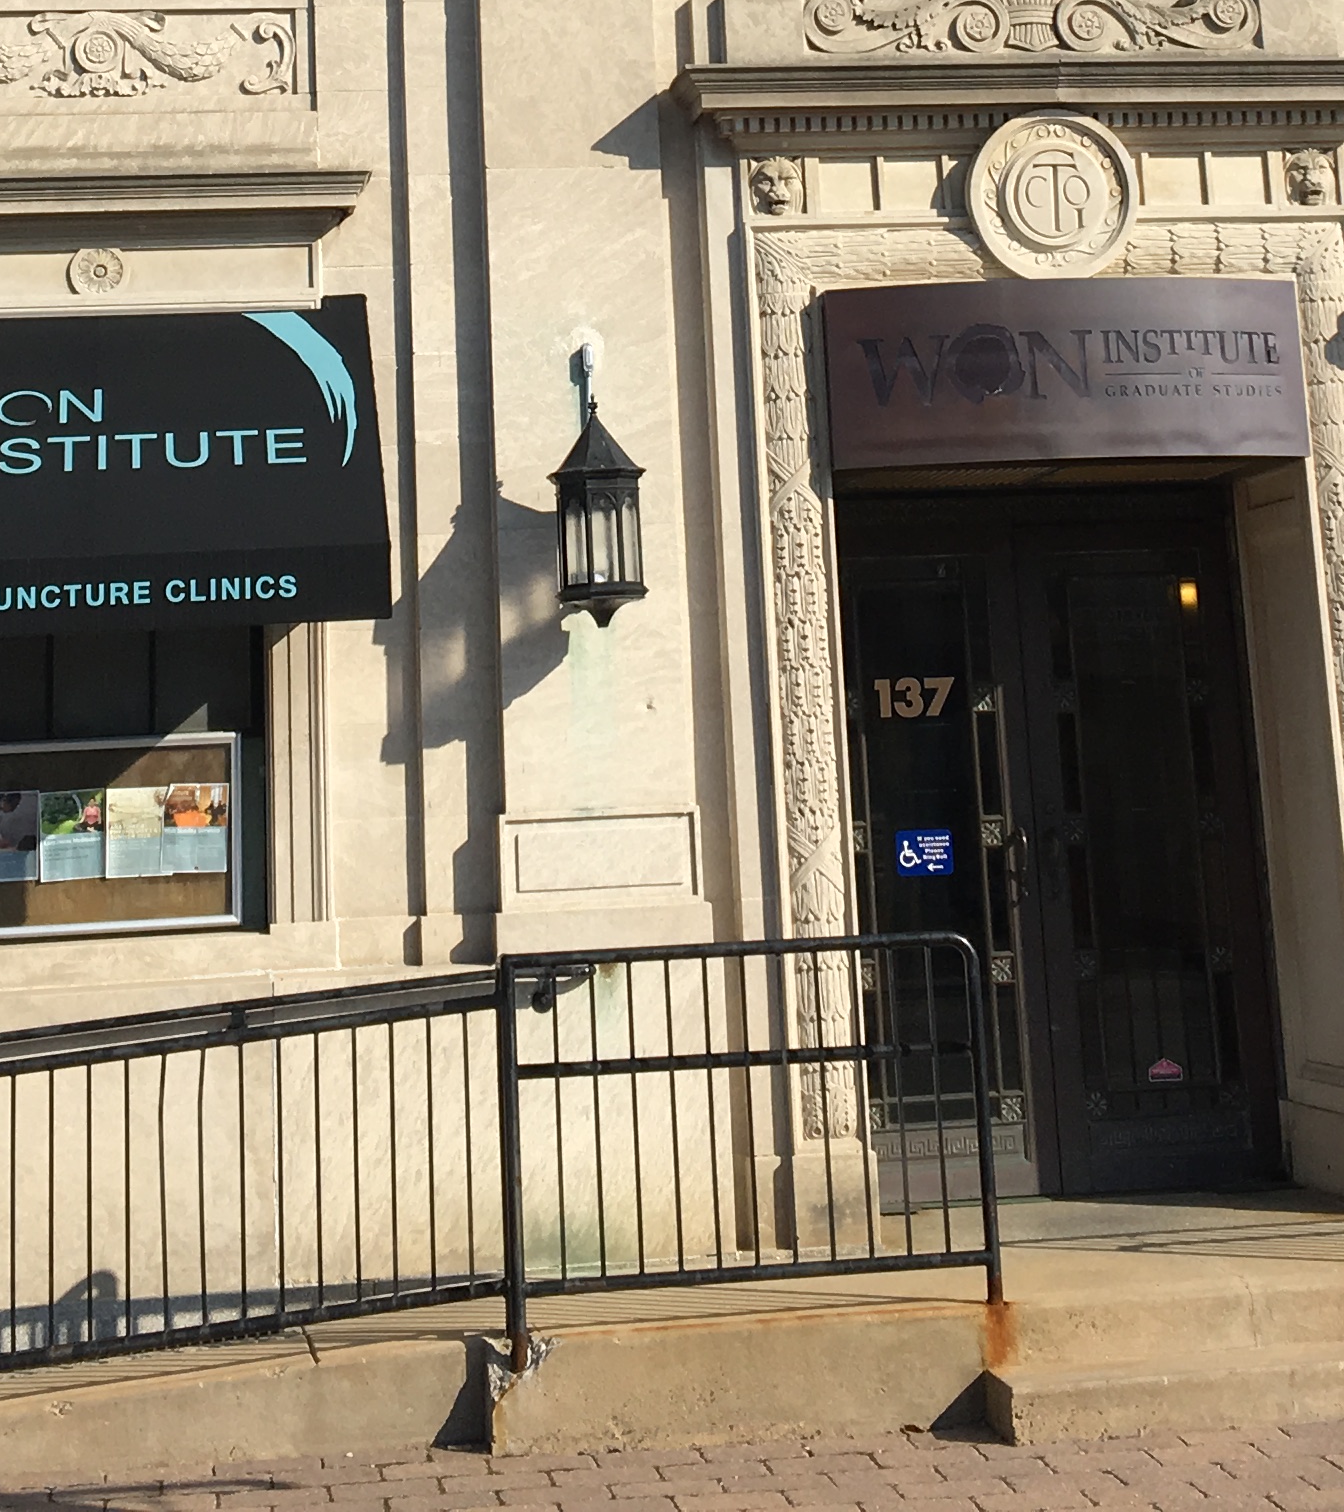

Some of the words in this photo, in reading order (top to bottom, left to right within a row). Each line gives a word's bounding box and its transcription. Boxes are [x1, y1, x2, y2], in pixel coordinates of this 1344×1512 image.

[858, 323, 1093, 408] WON
[1100, 329, 1281, 365] INSTITUTE
[1188, 366, 1206, 379] OF
[1104, 384, 1204, 398] GRADUATE
[1212, 384, 1283, 397] STUDIES
[164, 574, 299, 604] CLINICS
[873, 676, 956, 719] 137
